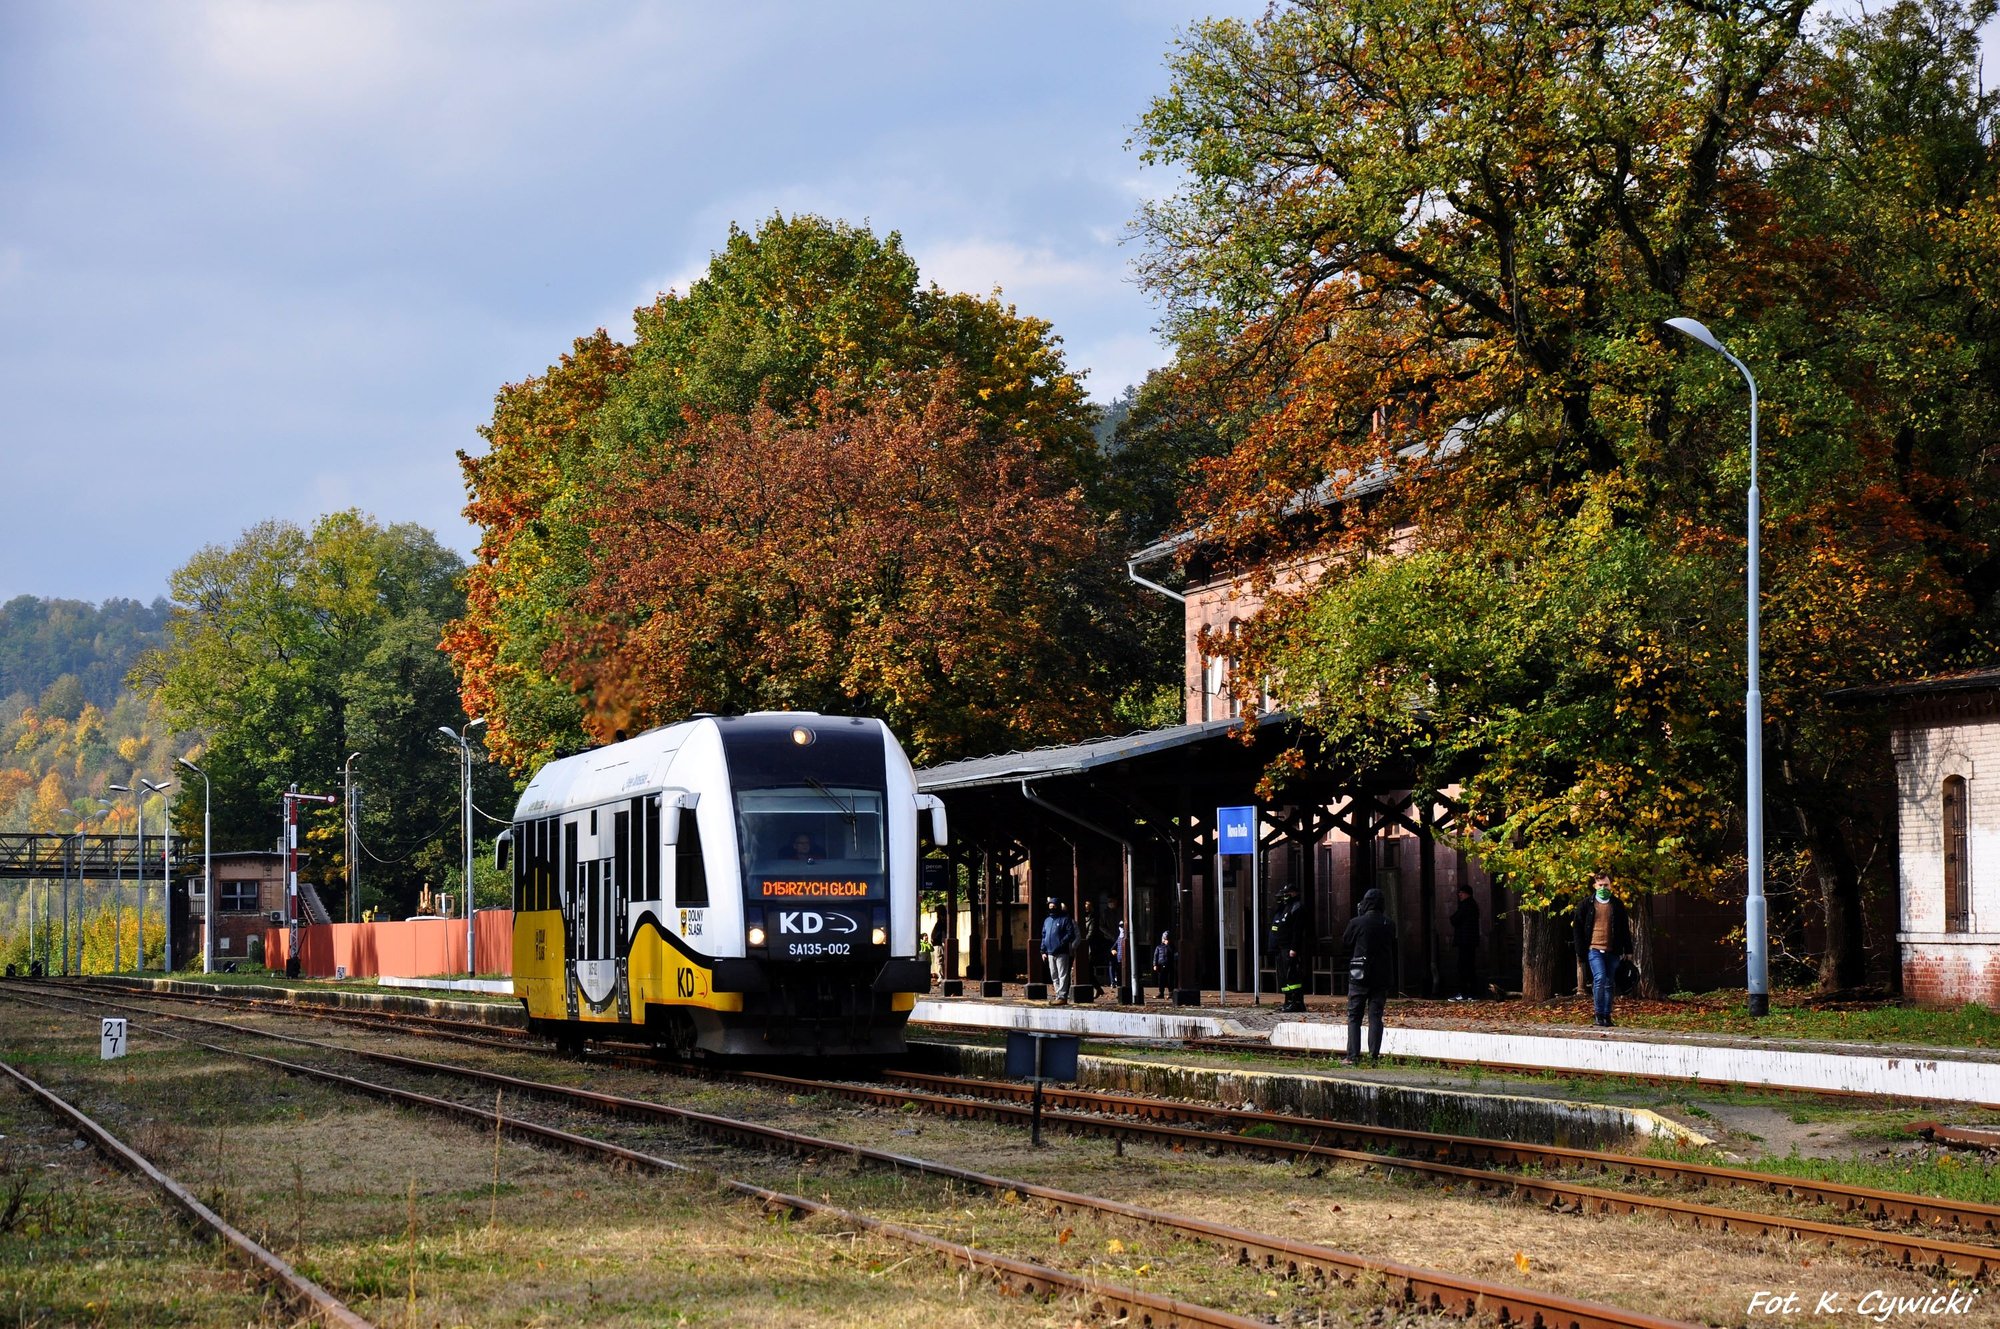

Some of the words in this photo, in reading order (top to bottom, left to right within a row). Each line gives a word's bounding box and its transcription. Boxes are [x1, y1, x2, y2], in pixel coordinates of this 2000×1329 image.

[688, 909, 704, 922] DOLNY
[780, 912, 823, 934] KD
[789, 943, 851, 955] SA135-002
[677, 967, 695, 998] KD
[104, 1021, 122, 1037] 21
[110, 1038, 118, 1053] 7
